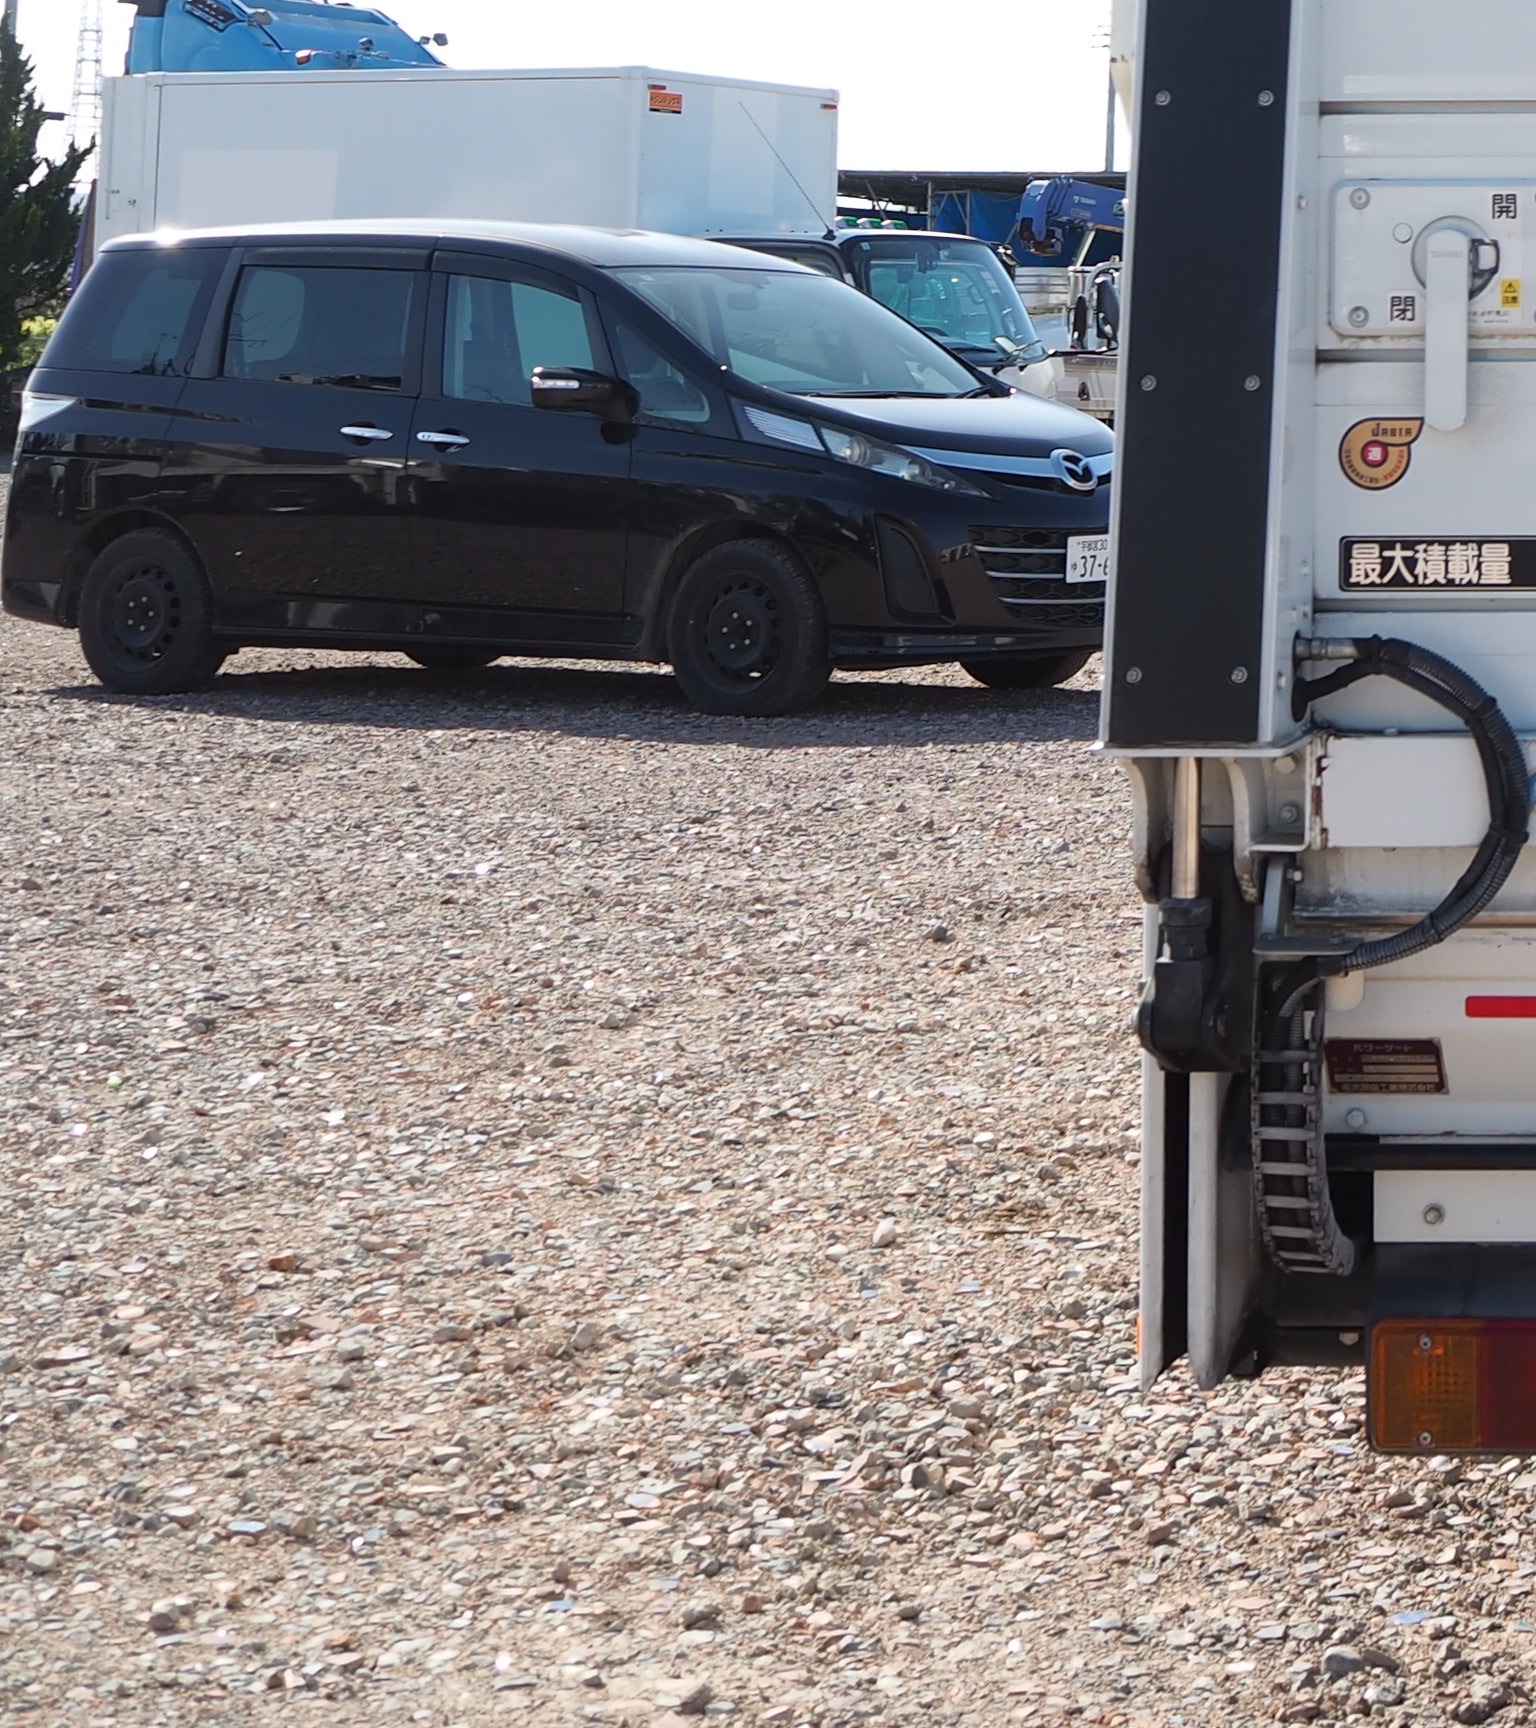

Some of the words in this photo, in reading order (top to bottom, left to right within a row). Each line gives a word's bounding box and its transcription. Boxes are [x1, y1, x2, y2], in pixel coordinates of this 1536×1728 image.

[1491, 193, 1517, 220] 開
[1390, 296, 1415, 322] 閉
[1349, 541, 1512, 585] 最大積載量
